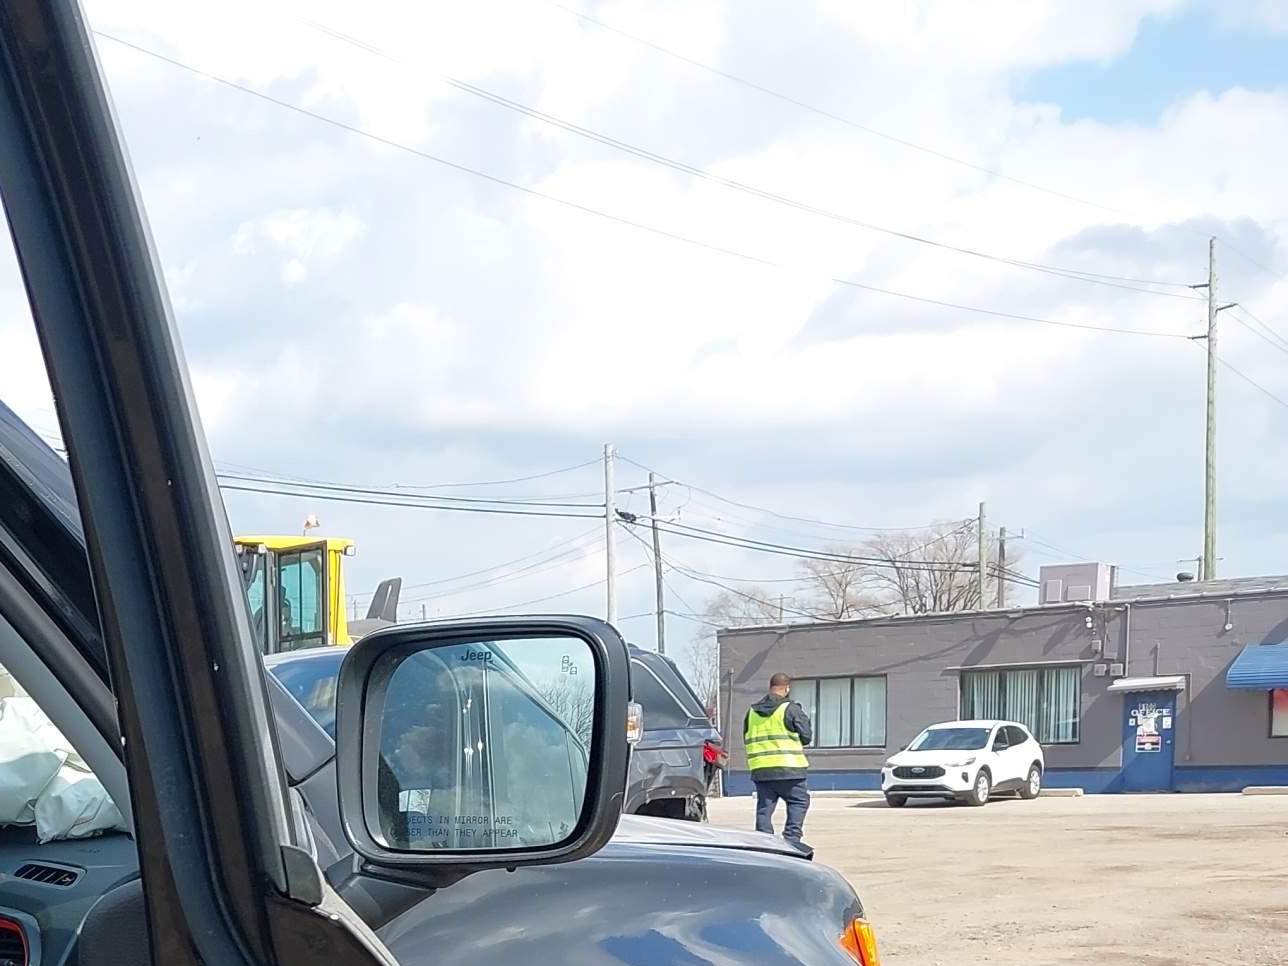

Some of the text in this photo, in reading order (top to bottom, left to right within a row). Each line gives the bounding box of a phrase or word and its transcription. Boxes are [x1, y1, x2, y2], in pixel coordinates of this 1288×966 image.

[460, 648, 492, 662] Jeep
[402, 815, 513, 825] JECTS IN MIRROR ARE
[428, 828, 450, 837] THAN
[456, 828, 476, 838] THEY
[482, 828, 518, 838] APPEAR
